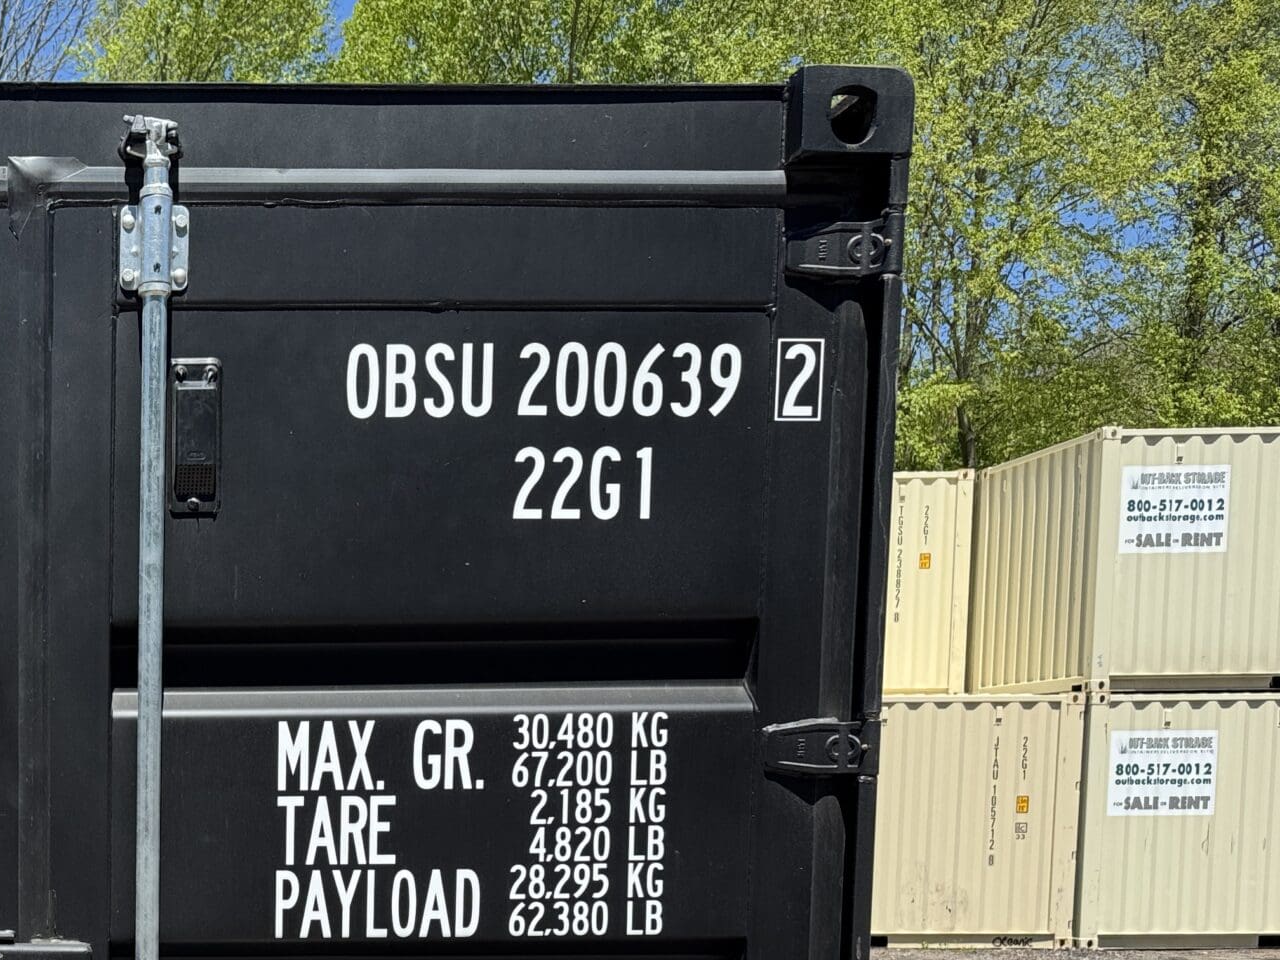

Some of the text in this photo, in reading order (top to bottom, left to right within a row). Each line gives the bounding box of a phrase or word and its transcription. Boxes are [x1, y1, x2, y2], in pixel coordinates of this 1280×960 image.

[346, 341, 818, 419] OBSU 200639 2
[512, 445, 654, 521] 22G1
[1126, 512, 1224, 524] outbackstorage.com
[1127, 498, 1225, 512] 800-517-0012
[1135, 532, 1172, 547] SALE
[1181, 532, 1223, 547] RENT
[277, 712, 669, 792] MAX. GR. 30,480 KG
[511, 750, 667, 788] 67,200 LB
[1115, 763, 1212, 776] 800-517-0012
[989, 785, 997, 850] 105712
[1169, 796, 1210, 810] RENT
[277, 787, 666, 865] TARE 2,185 KG
[529, 825, 665, 863] 4,820 LB
[275, 863, 665, 938] PAYLOAD 28,295 KG
[508, 899, 664, 937] 62,380 LB
